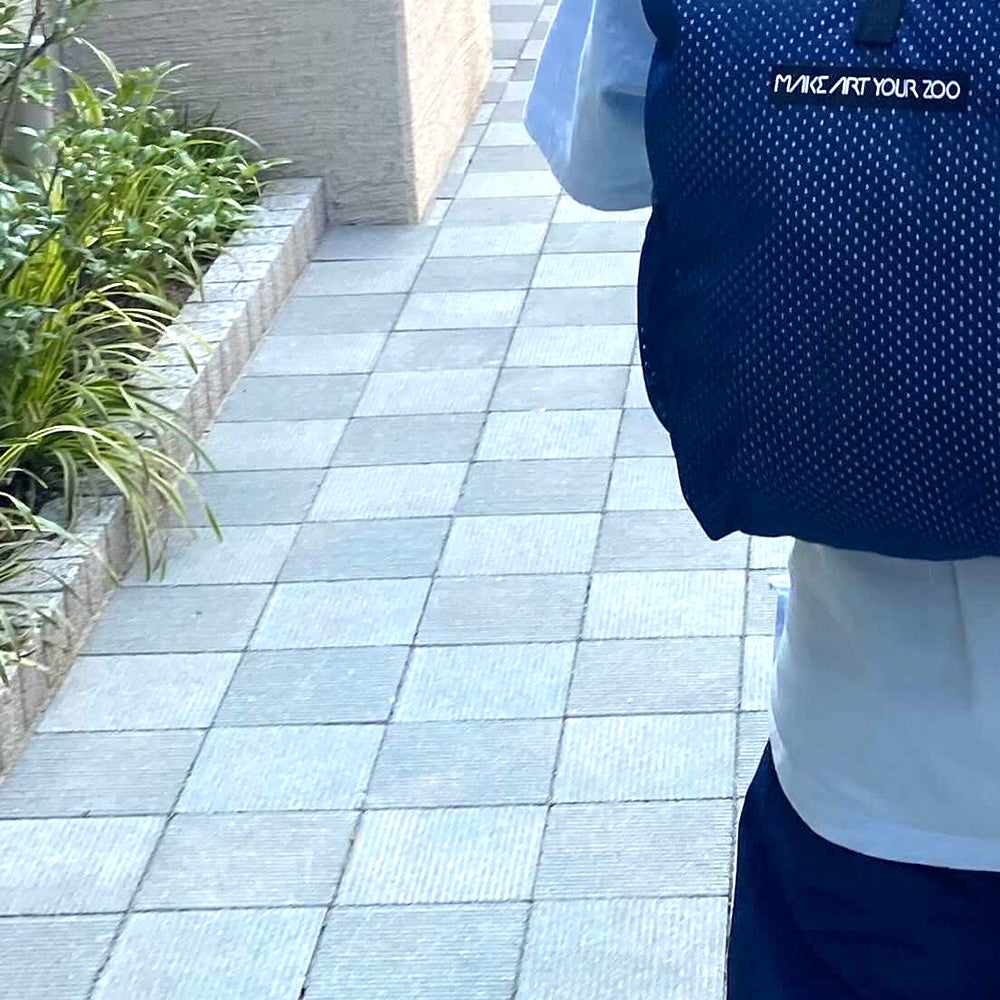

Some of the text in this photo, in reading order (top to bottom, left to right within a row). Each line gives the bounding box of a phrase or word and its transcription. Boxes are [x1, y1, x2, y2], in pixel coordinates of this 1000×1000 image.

[774, 74, 961, 100] MAKE ART YOUR ZOO
